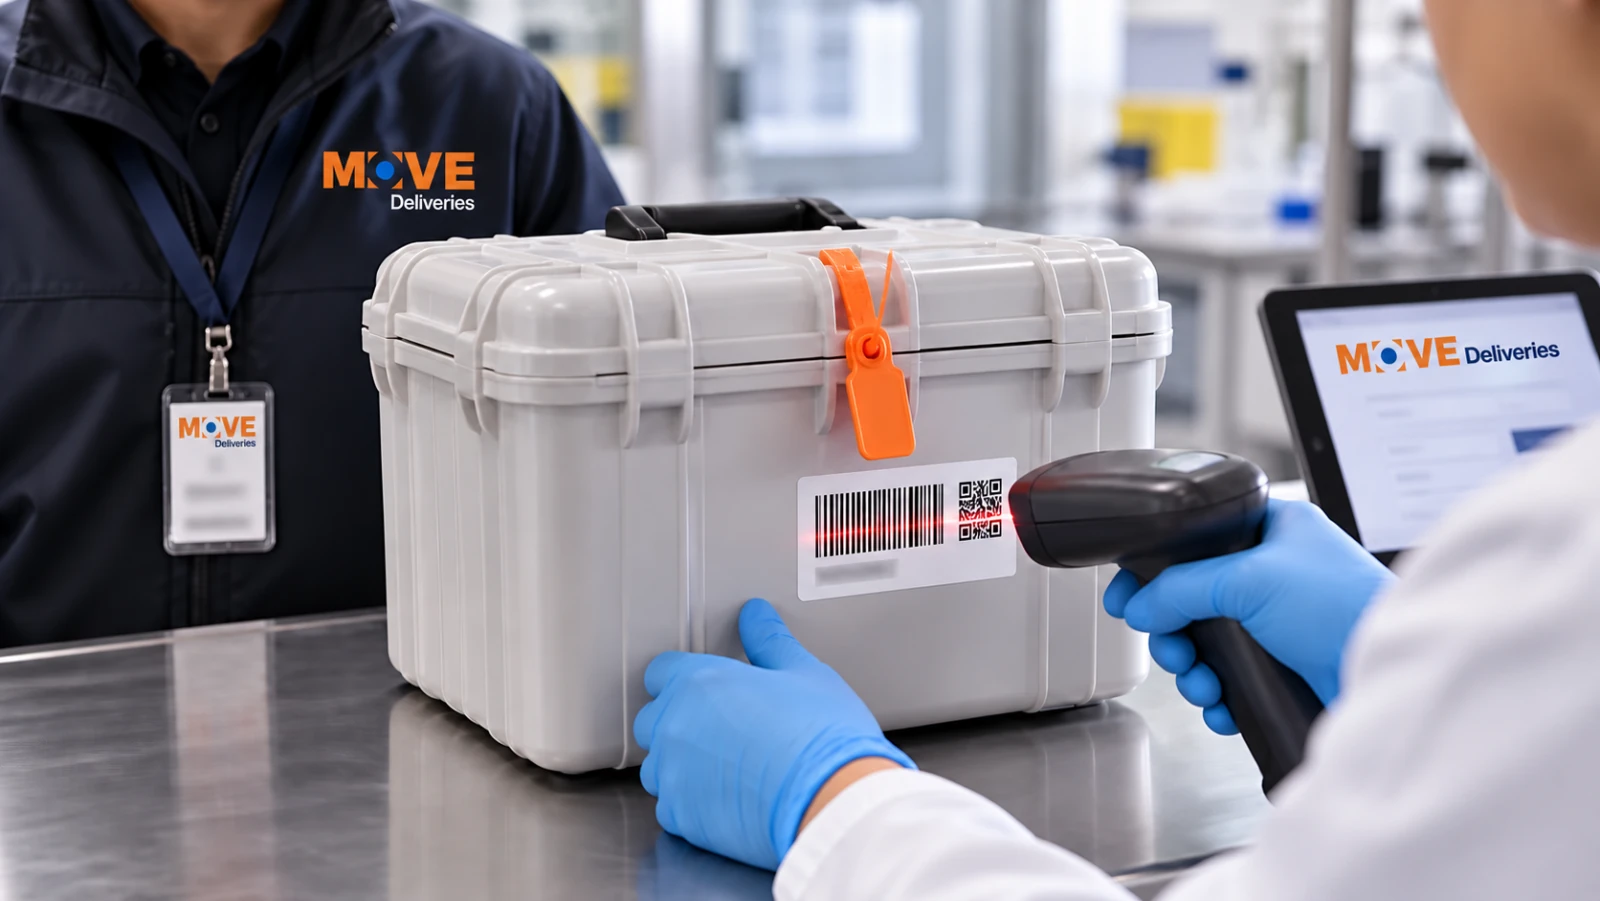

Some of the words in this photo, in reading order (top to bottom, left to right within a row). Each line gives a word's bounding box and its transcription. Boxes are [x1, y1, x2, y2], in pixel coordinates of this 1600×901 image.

[323, 151, 475, 190] MOVE
[390, 194, 475, 211] Deliveries
[1336, 335, 1461, 374] MOVE
[1464, 341, 1560, 365] Deliveries
[178, 416, 256, 439] MOVE
[214, 438, 256, 448] Deliveries
